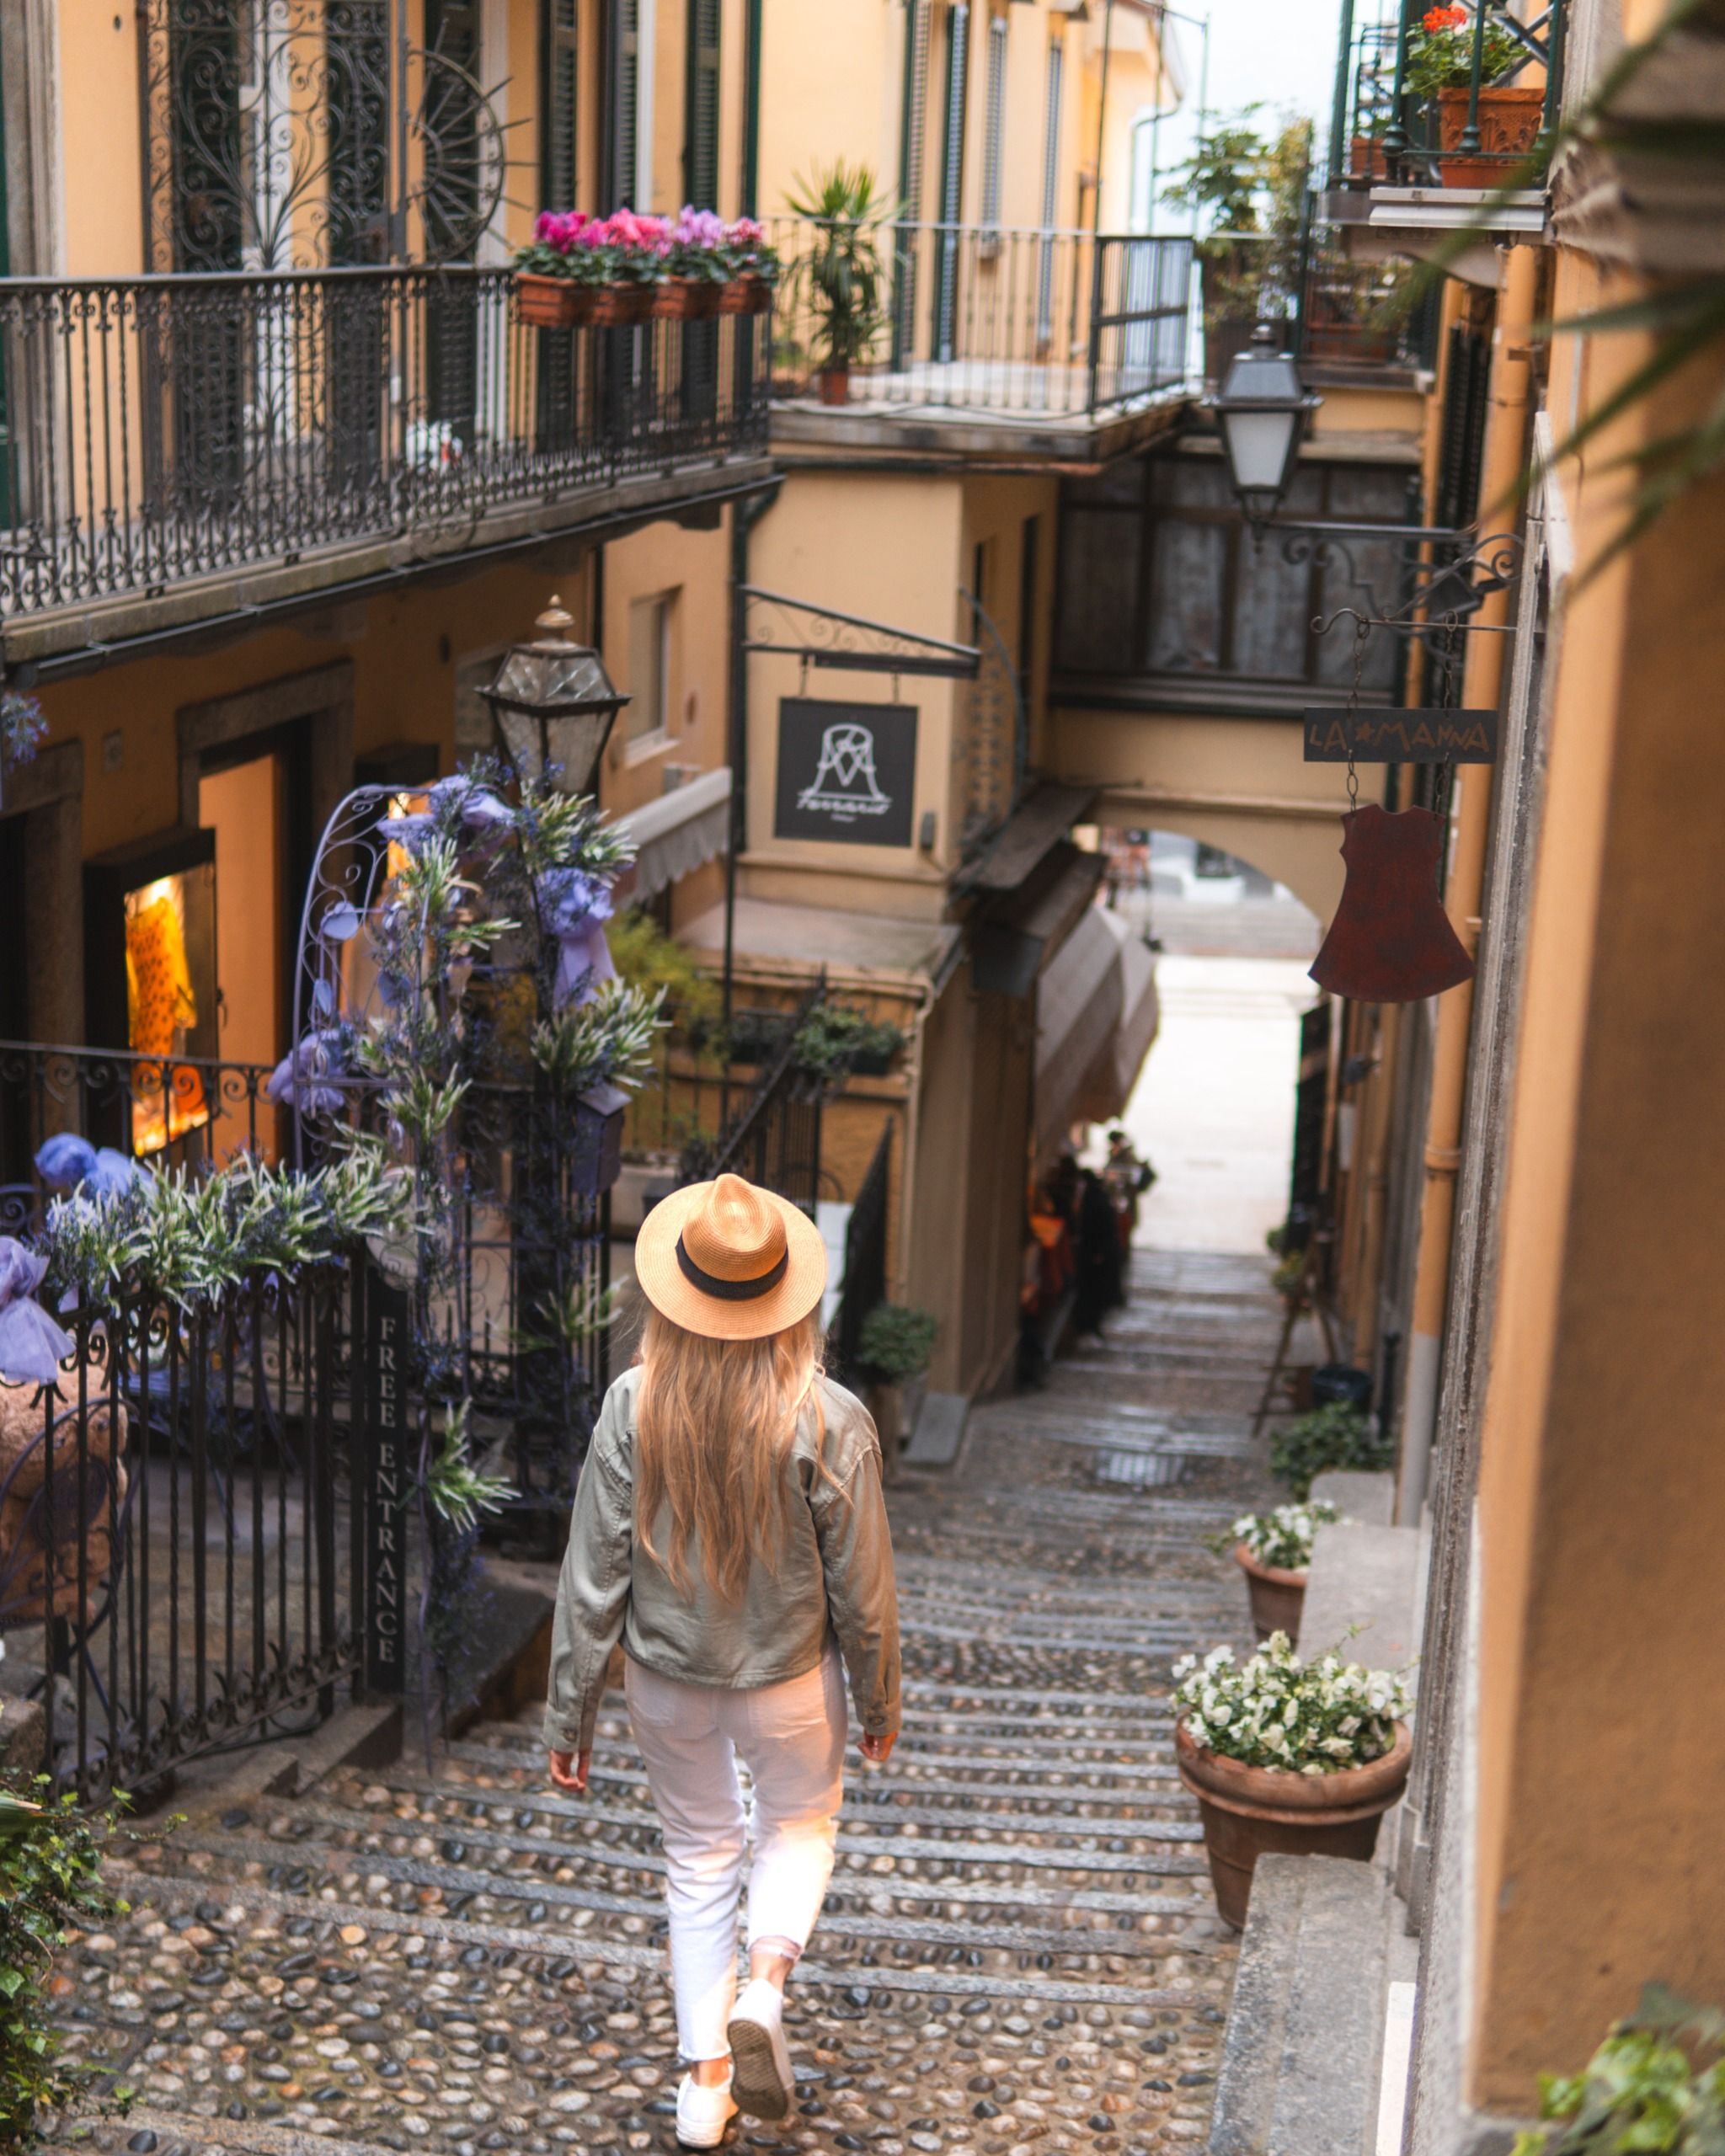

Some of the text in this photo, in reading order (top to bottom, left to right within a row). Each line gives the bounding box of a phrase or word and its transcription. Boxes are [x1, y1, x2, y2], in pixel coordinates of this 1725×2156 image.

[1309, 720, 1348, 753] LA
[376, 1316, 398, 1663] FREE ENTRANCE
